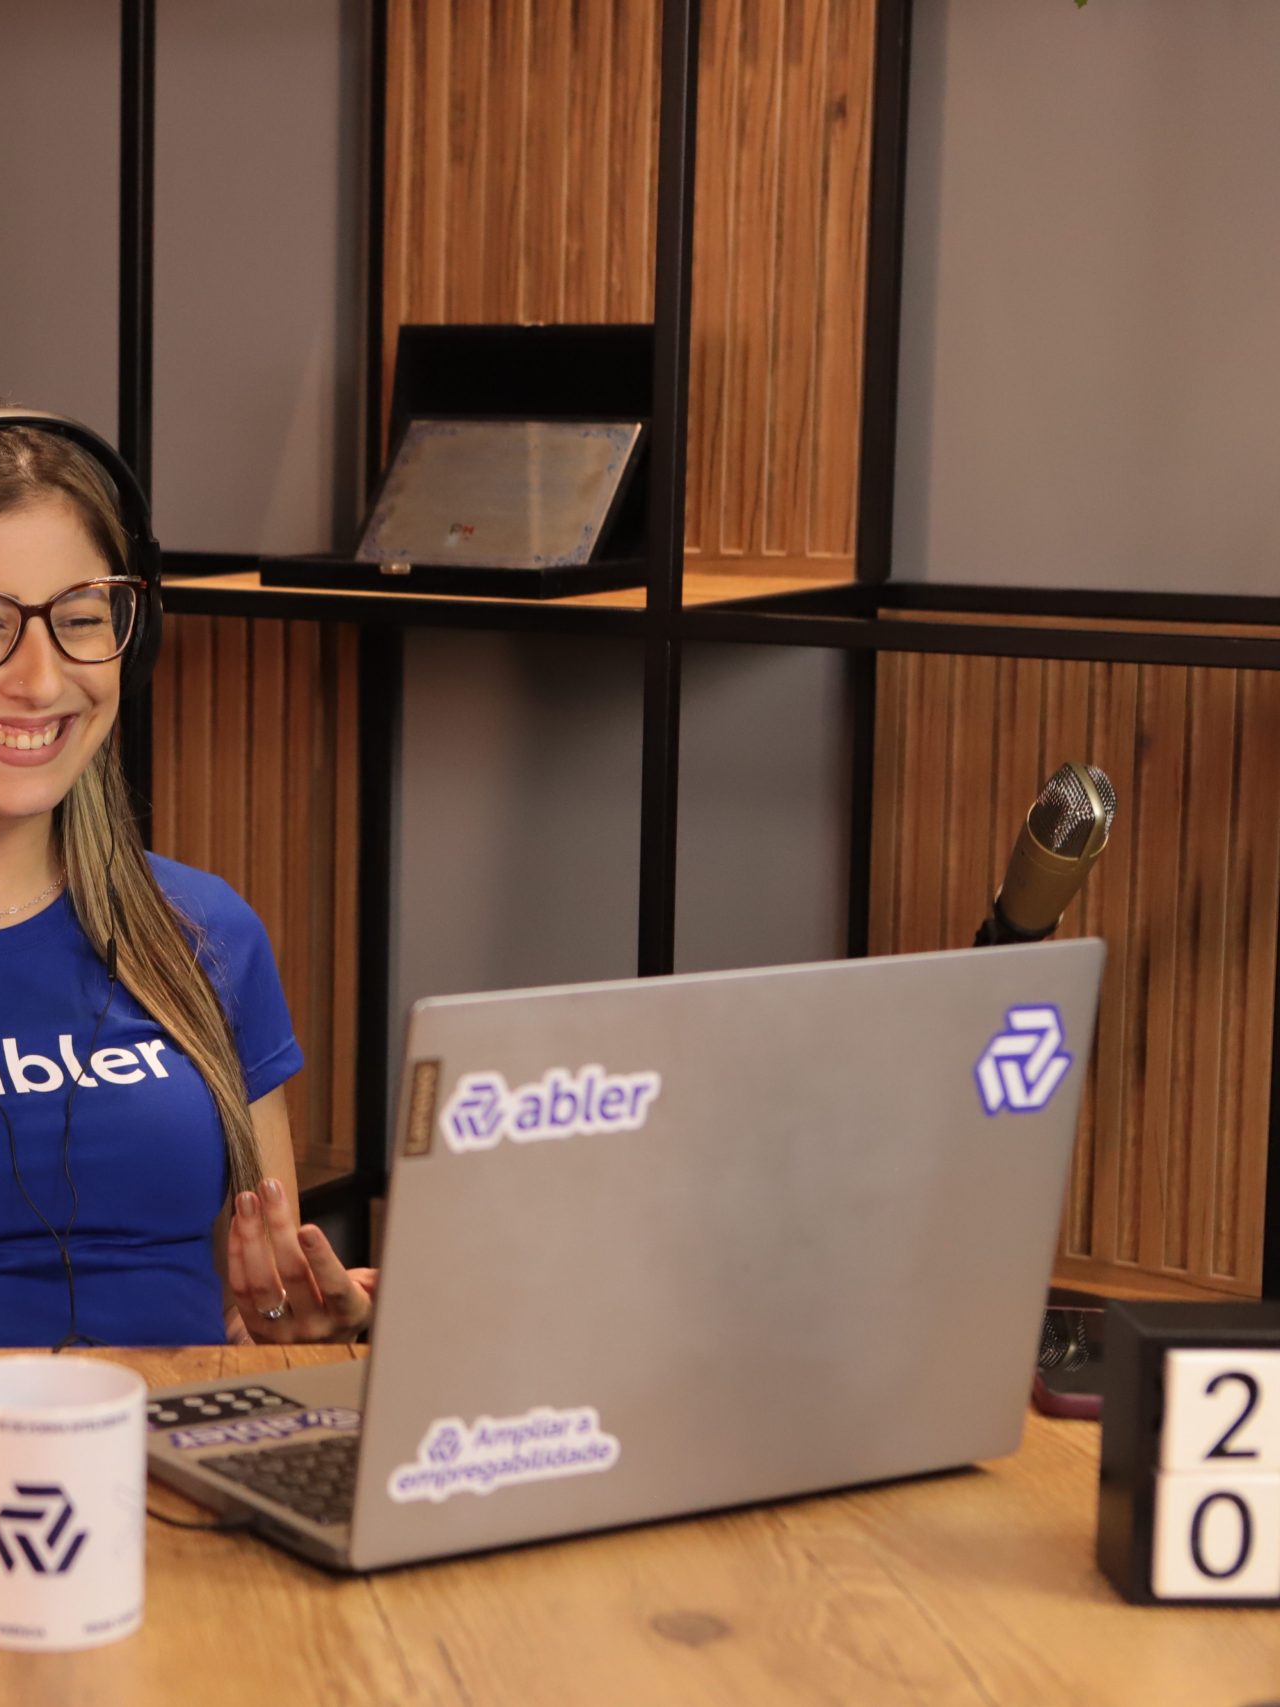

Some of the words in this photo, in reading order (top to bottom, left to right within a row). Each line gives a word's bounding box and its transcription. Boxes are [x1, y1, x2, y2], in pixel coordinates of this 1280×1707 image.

[515, 1076, 651, 1130] abler
[1204, 1371, 1260, 1460] 2
[1190, 1491, 1253, 1580] 0
